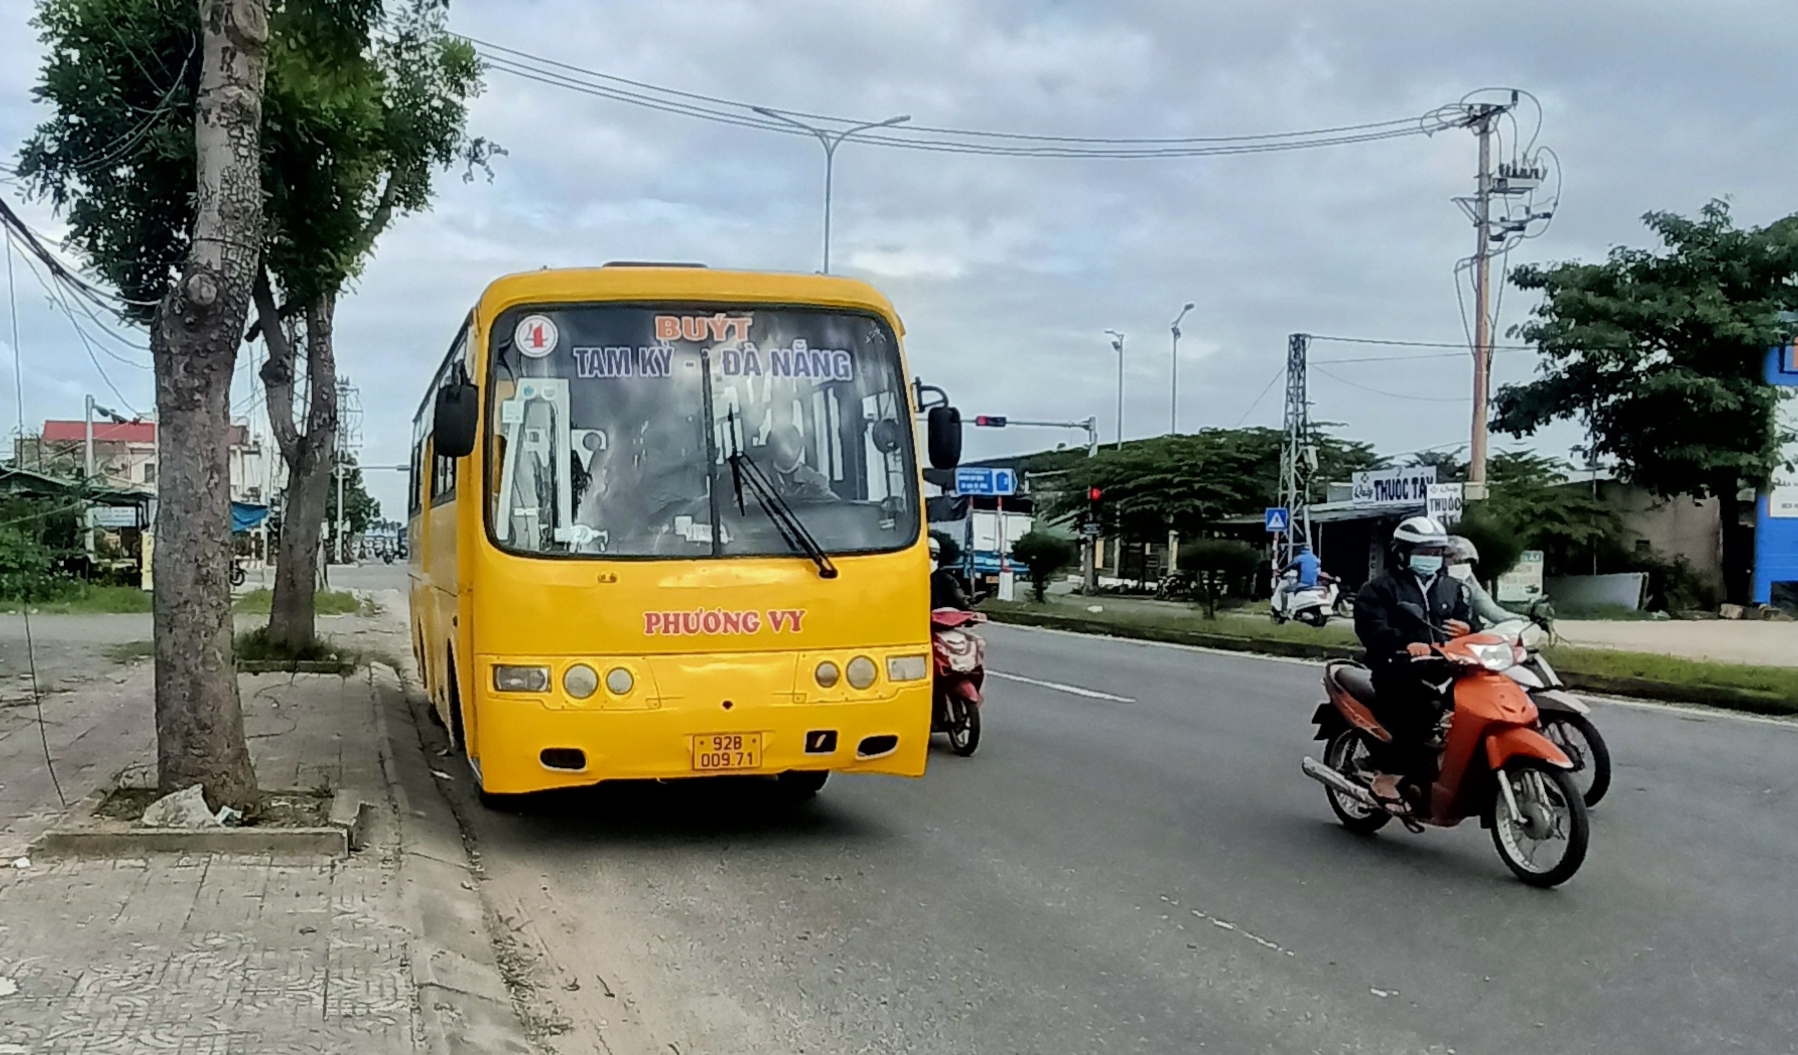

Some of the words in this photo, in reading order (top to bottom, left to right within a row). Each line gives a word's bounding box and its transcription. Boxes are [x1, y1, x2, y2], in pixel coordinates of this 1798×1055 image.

[523, 322, 549, 348] 4
[655, 313, 752, 341] BUÝT
[574, 347, 633, 378] TAM
[638, 339, 675, 378] KỲ
[721, 342, 763, 378] ĐÀ
[769, 339, 853, 380] NẴNG
[643, 607, 762, 636] PHƯƠNG
[766, 609, 807, 634] VY
[713, 735, 743, 751] 92B
[701, 751, 753, 768] 009.71
